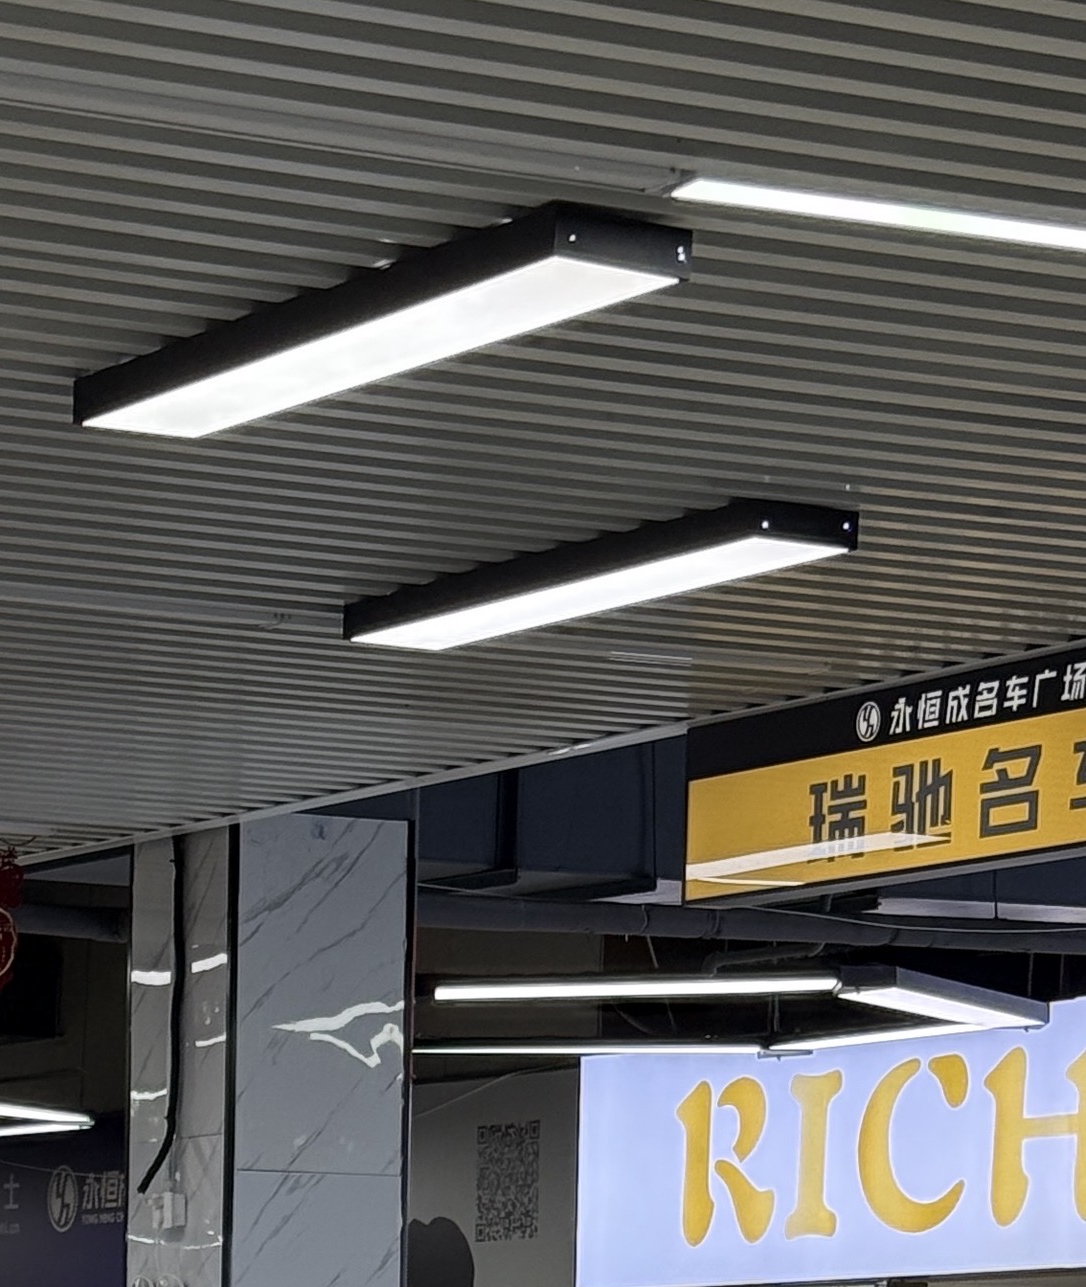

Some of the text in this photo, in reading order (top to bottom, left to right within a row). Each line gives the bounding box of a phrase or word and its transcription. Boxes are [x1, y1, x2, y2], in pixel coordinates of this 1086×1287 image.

[889, 661, 1086, 736] 永恒成名车广场
[675, 1045, 1086, 1247] RICH
